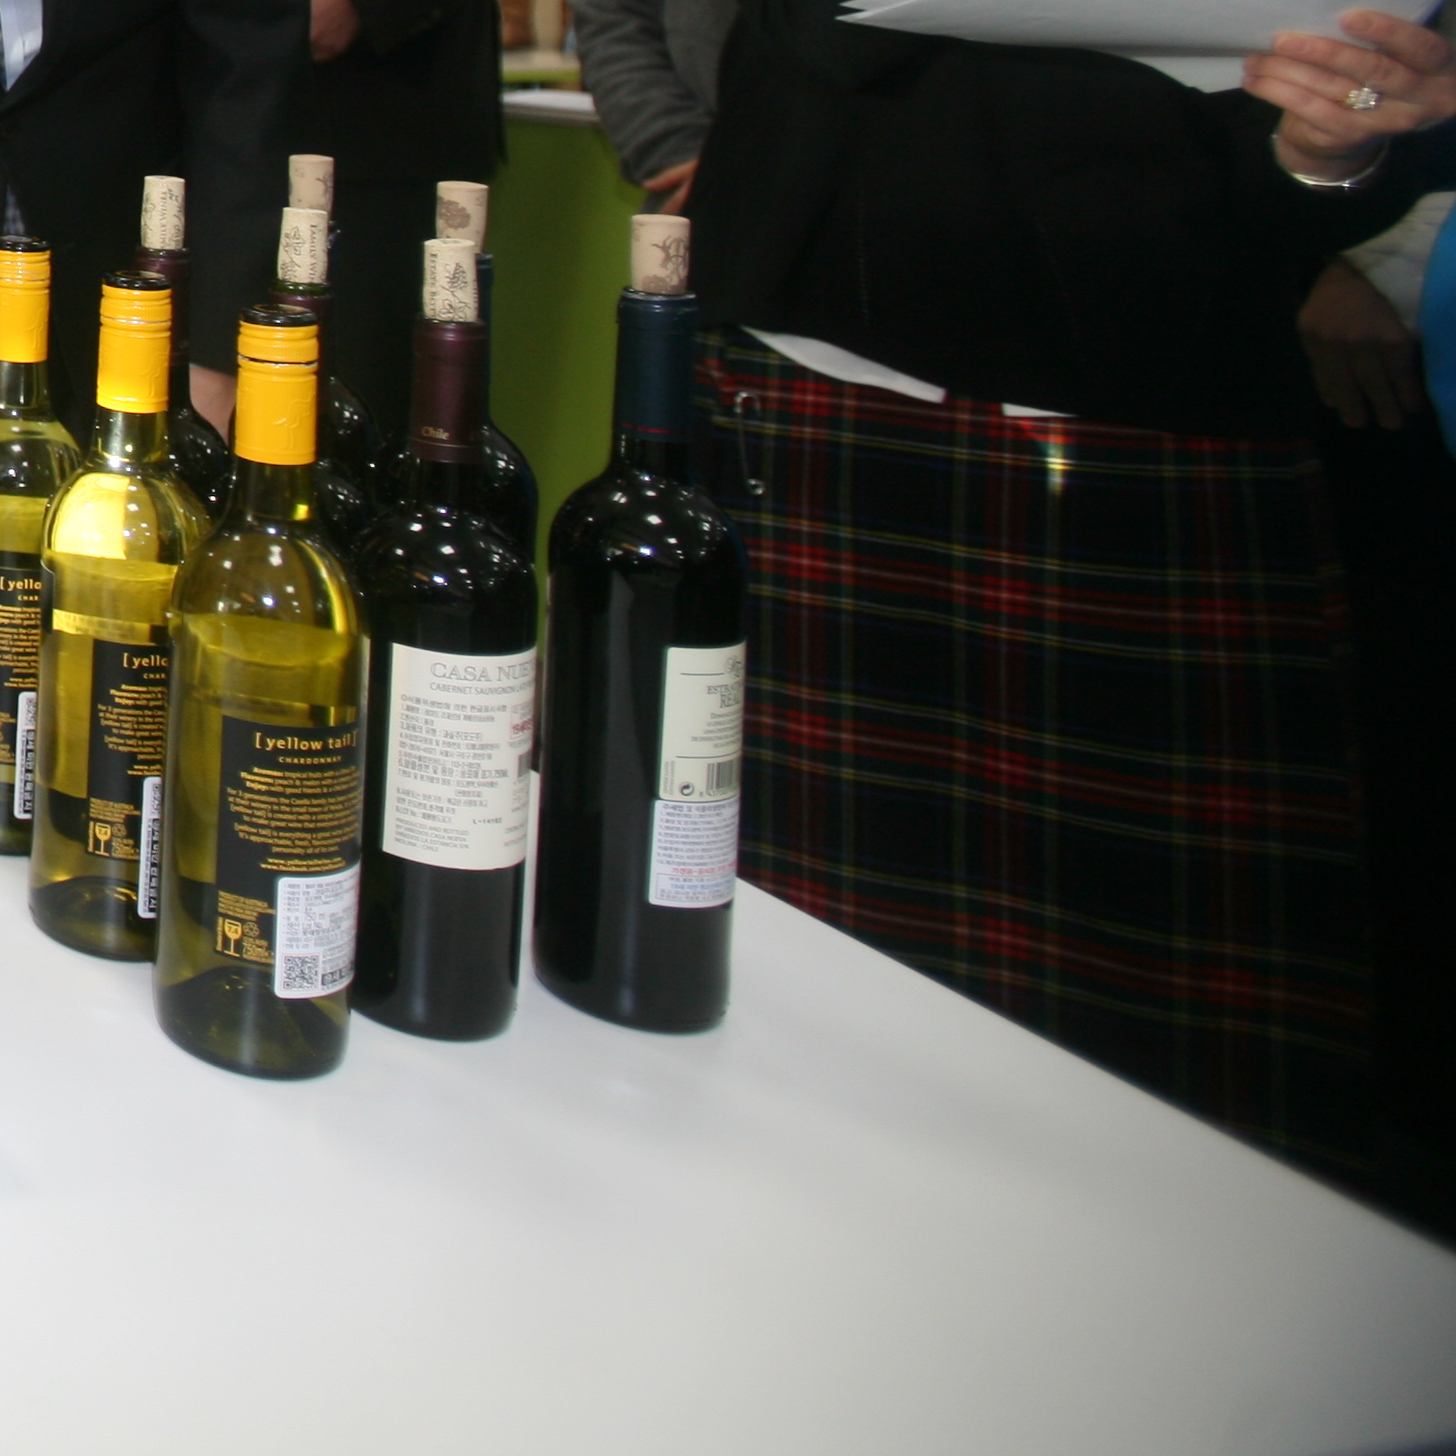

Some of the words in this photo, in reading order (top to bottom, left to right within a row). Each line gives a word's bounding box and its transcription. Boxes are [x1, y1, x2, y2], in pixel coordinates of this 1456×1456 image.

[430, 662, 492, 682] CASA
[497, 659, 532, 682] NUE
[429, 682, 473, 695] CABERNET
[278, 755, 342, 765] CHARDONNAY
